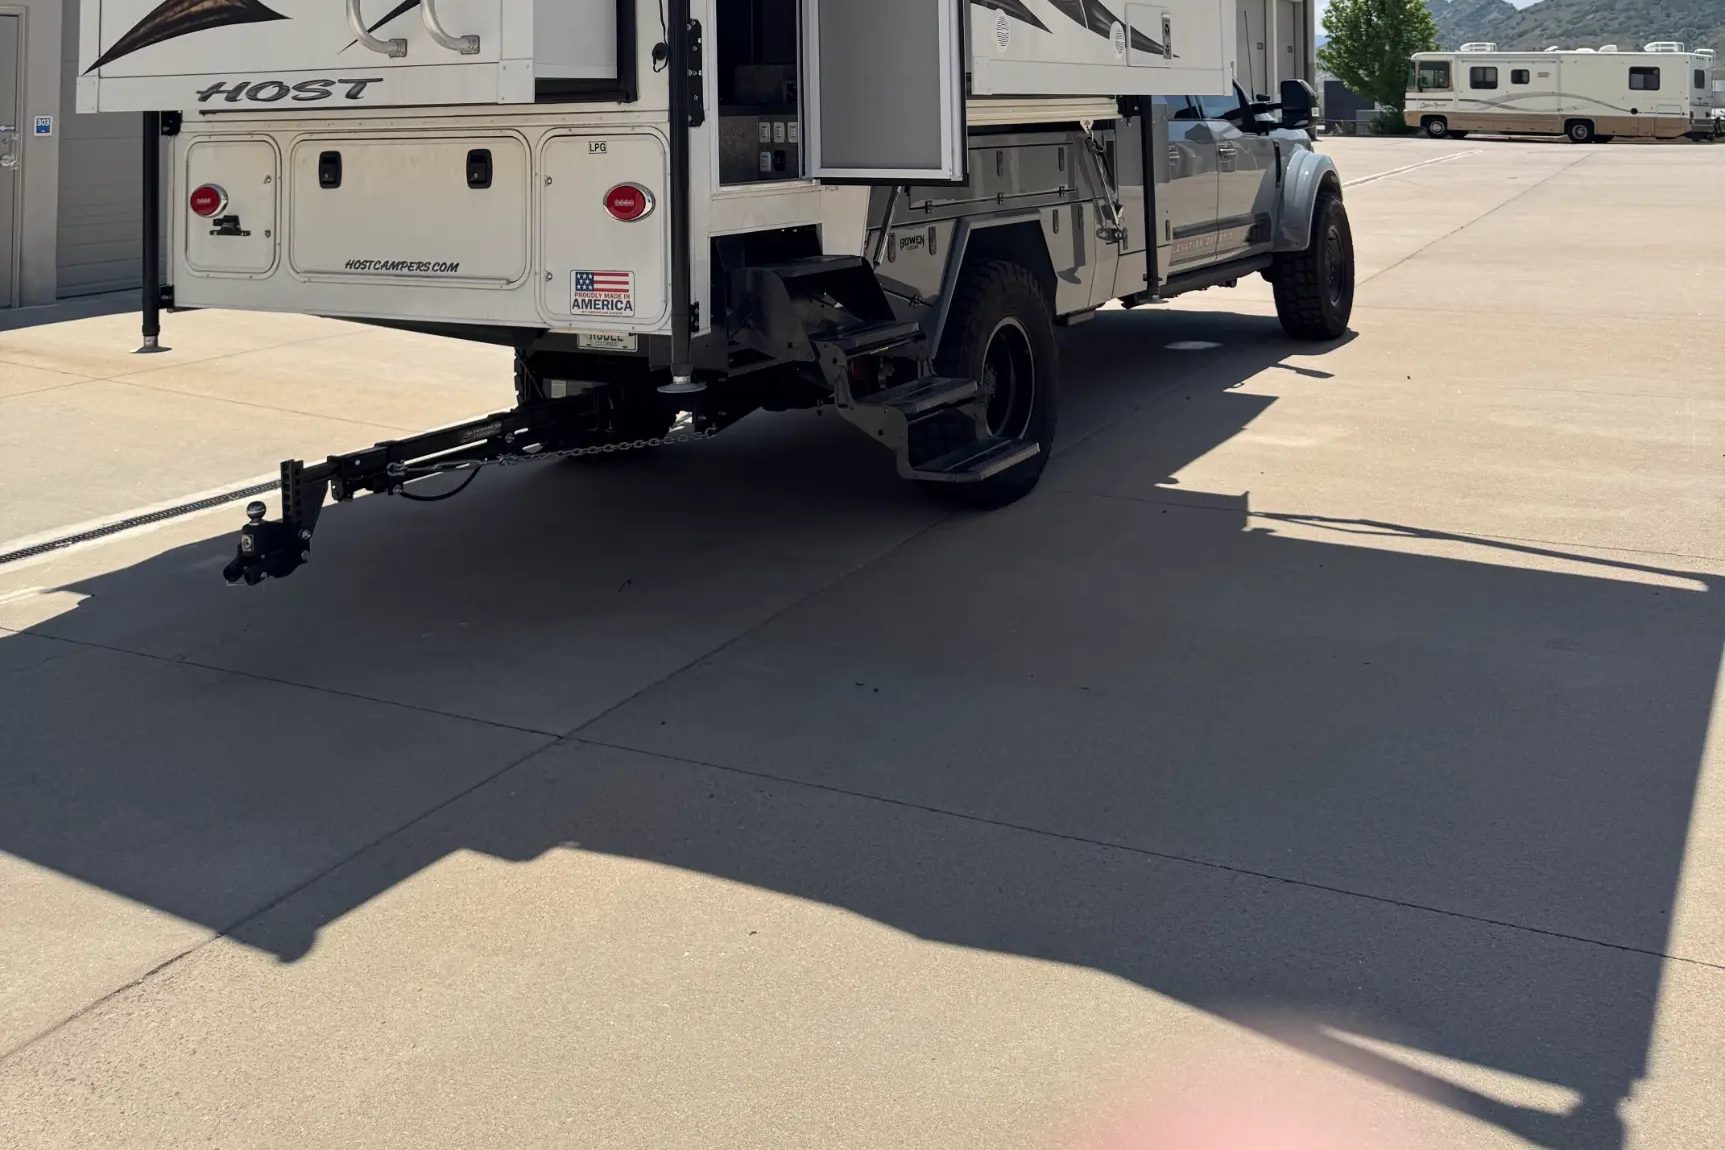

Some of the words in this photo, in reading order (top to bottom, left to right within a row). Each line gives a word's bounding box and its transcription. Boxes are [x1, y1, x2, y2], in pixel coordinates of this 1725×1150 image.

[195, 77, 384, 103] HOST
[589, 142, 607, 152] LPG
[900, 234, 924, 250] BOWEN
[344, 259, 460, 273] HOSTCAMPERS.COM
[572, 298, 633, 312] AMERICA
